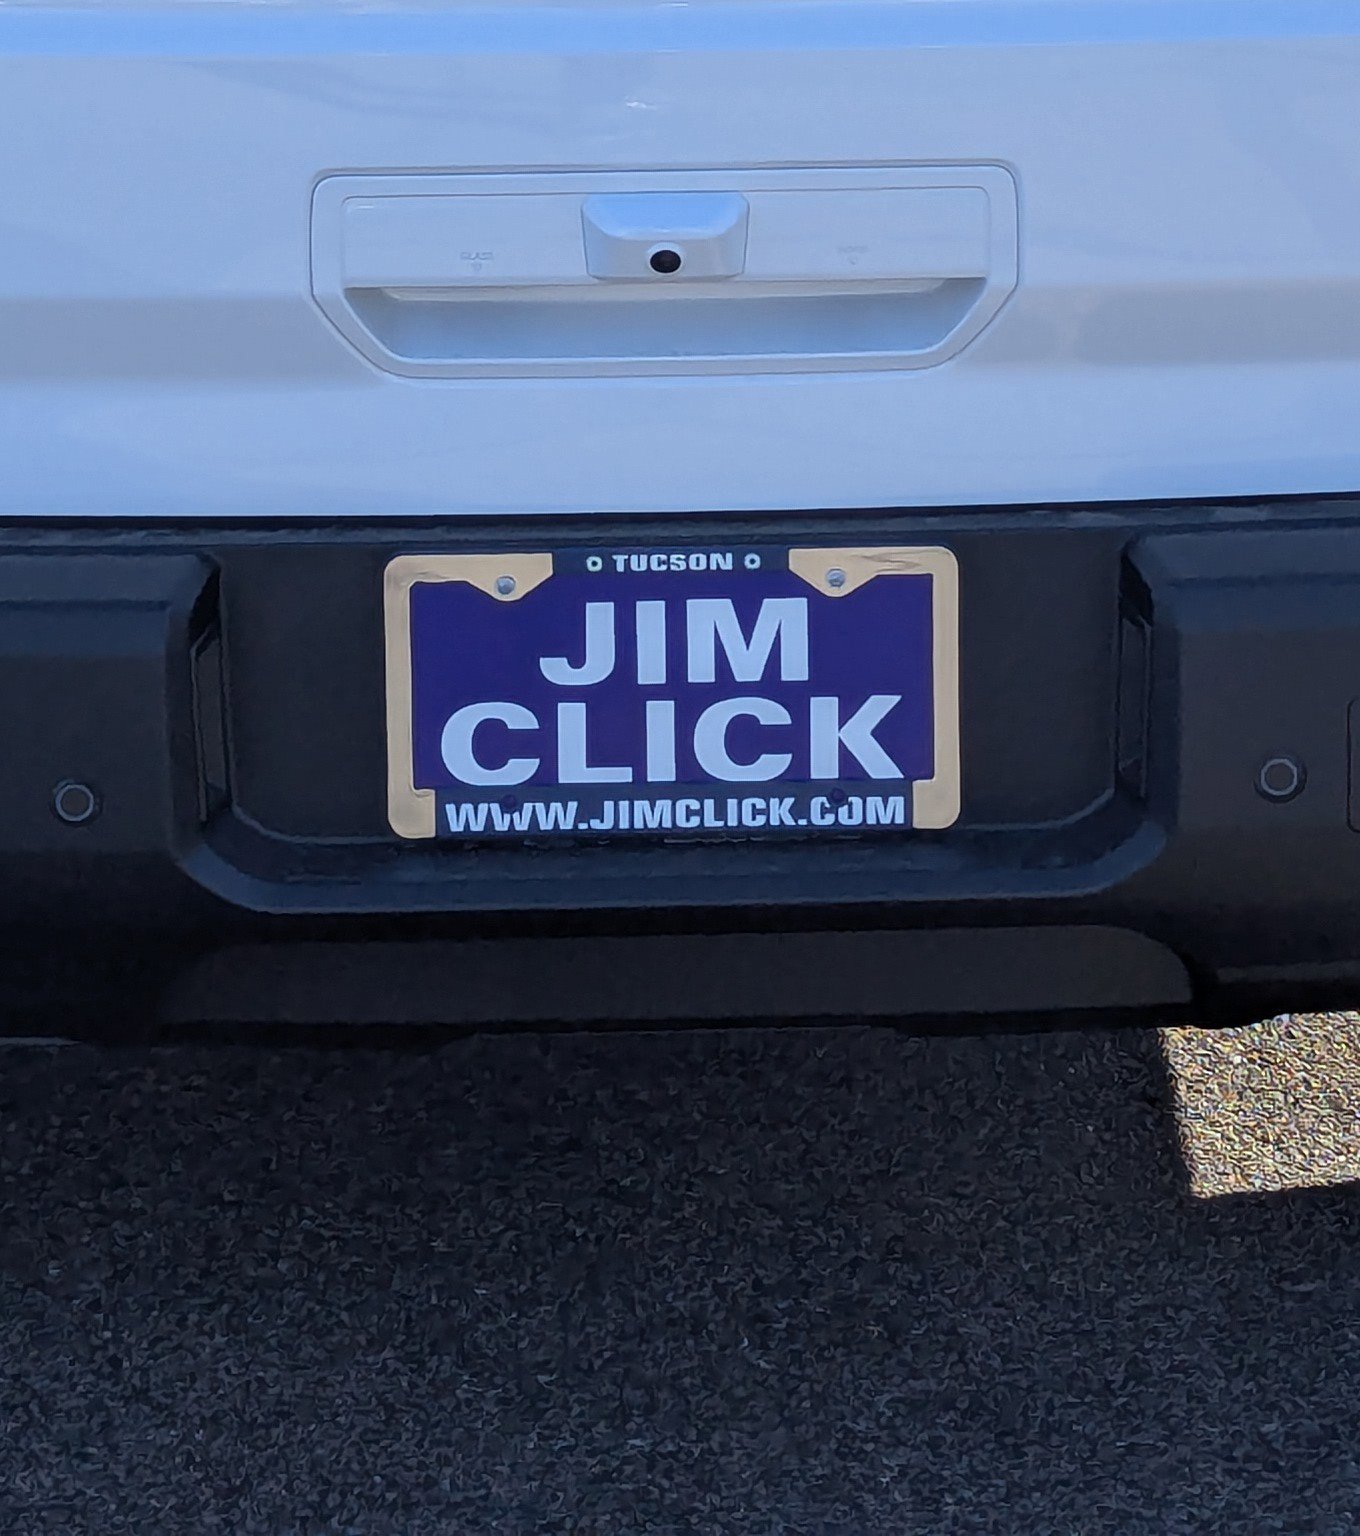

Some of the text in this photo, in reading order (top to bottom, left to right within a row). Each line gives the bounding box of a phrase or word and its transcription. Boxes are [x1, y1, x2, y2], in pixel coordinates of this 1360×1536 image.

[612, 552, 734, 573] TUCSON
[539, 596, 810, 686] JIM
[440, 694, 905, 786] CLICK
[445, 795, 906, 833] WWW.JIMCLICK.COM
